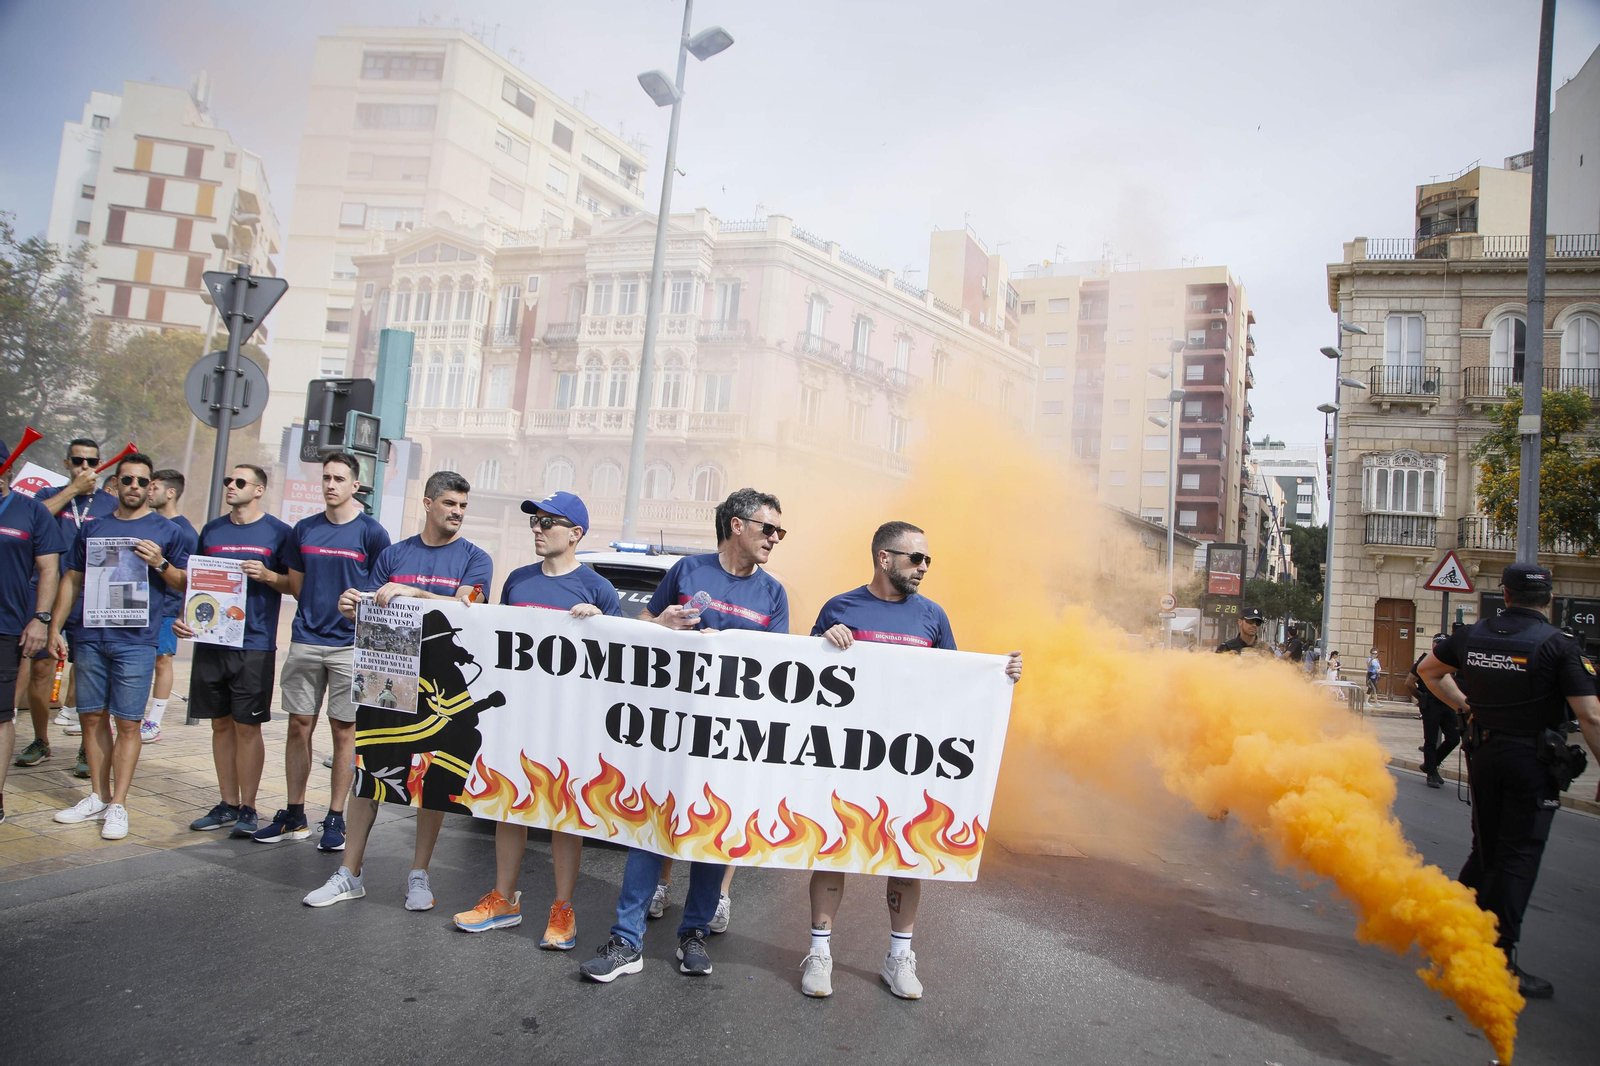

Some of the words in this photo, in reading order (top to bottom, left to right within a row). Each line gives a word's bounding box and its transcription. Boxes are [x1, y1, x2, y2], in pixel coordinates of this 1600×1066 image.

[12, 486, 36, 498] ALME
[292, 483, 307, 492] DA
[310, 484, 322, 492] IG
[367, 608, 399, 617] MALVERSA
[364, 615, 388, 623] FONDOS
[389, 618, 414, 627] UNESPA
[903, 637, 928, 646] BOMBEROS
[368, 658, 388, 666] DINERO
[1468, 652, 1513, 662] POLICIA
[356, 663, 378, 671] PARQUE
[387, 668, 417, 676] BOMBEROS
[495, 631, 854, 708] BOMBEROS
[1467, 659, 1526, 672] NACIONAL
[606, 703, 974, 780] QUEMADOS
